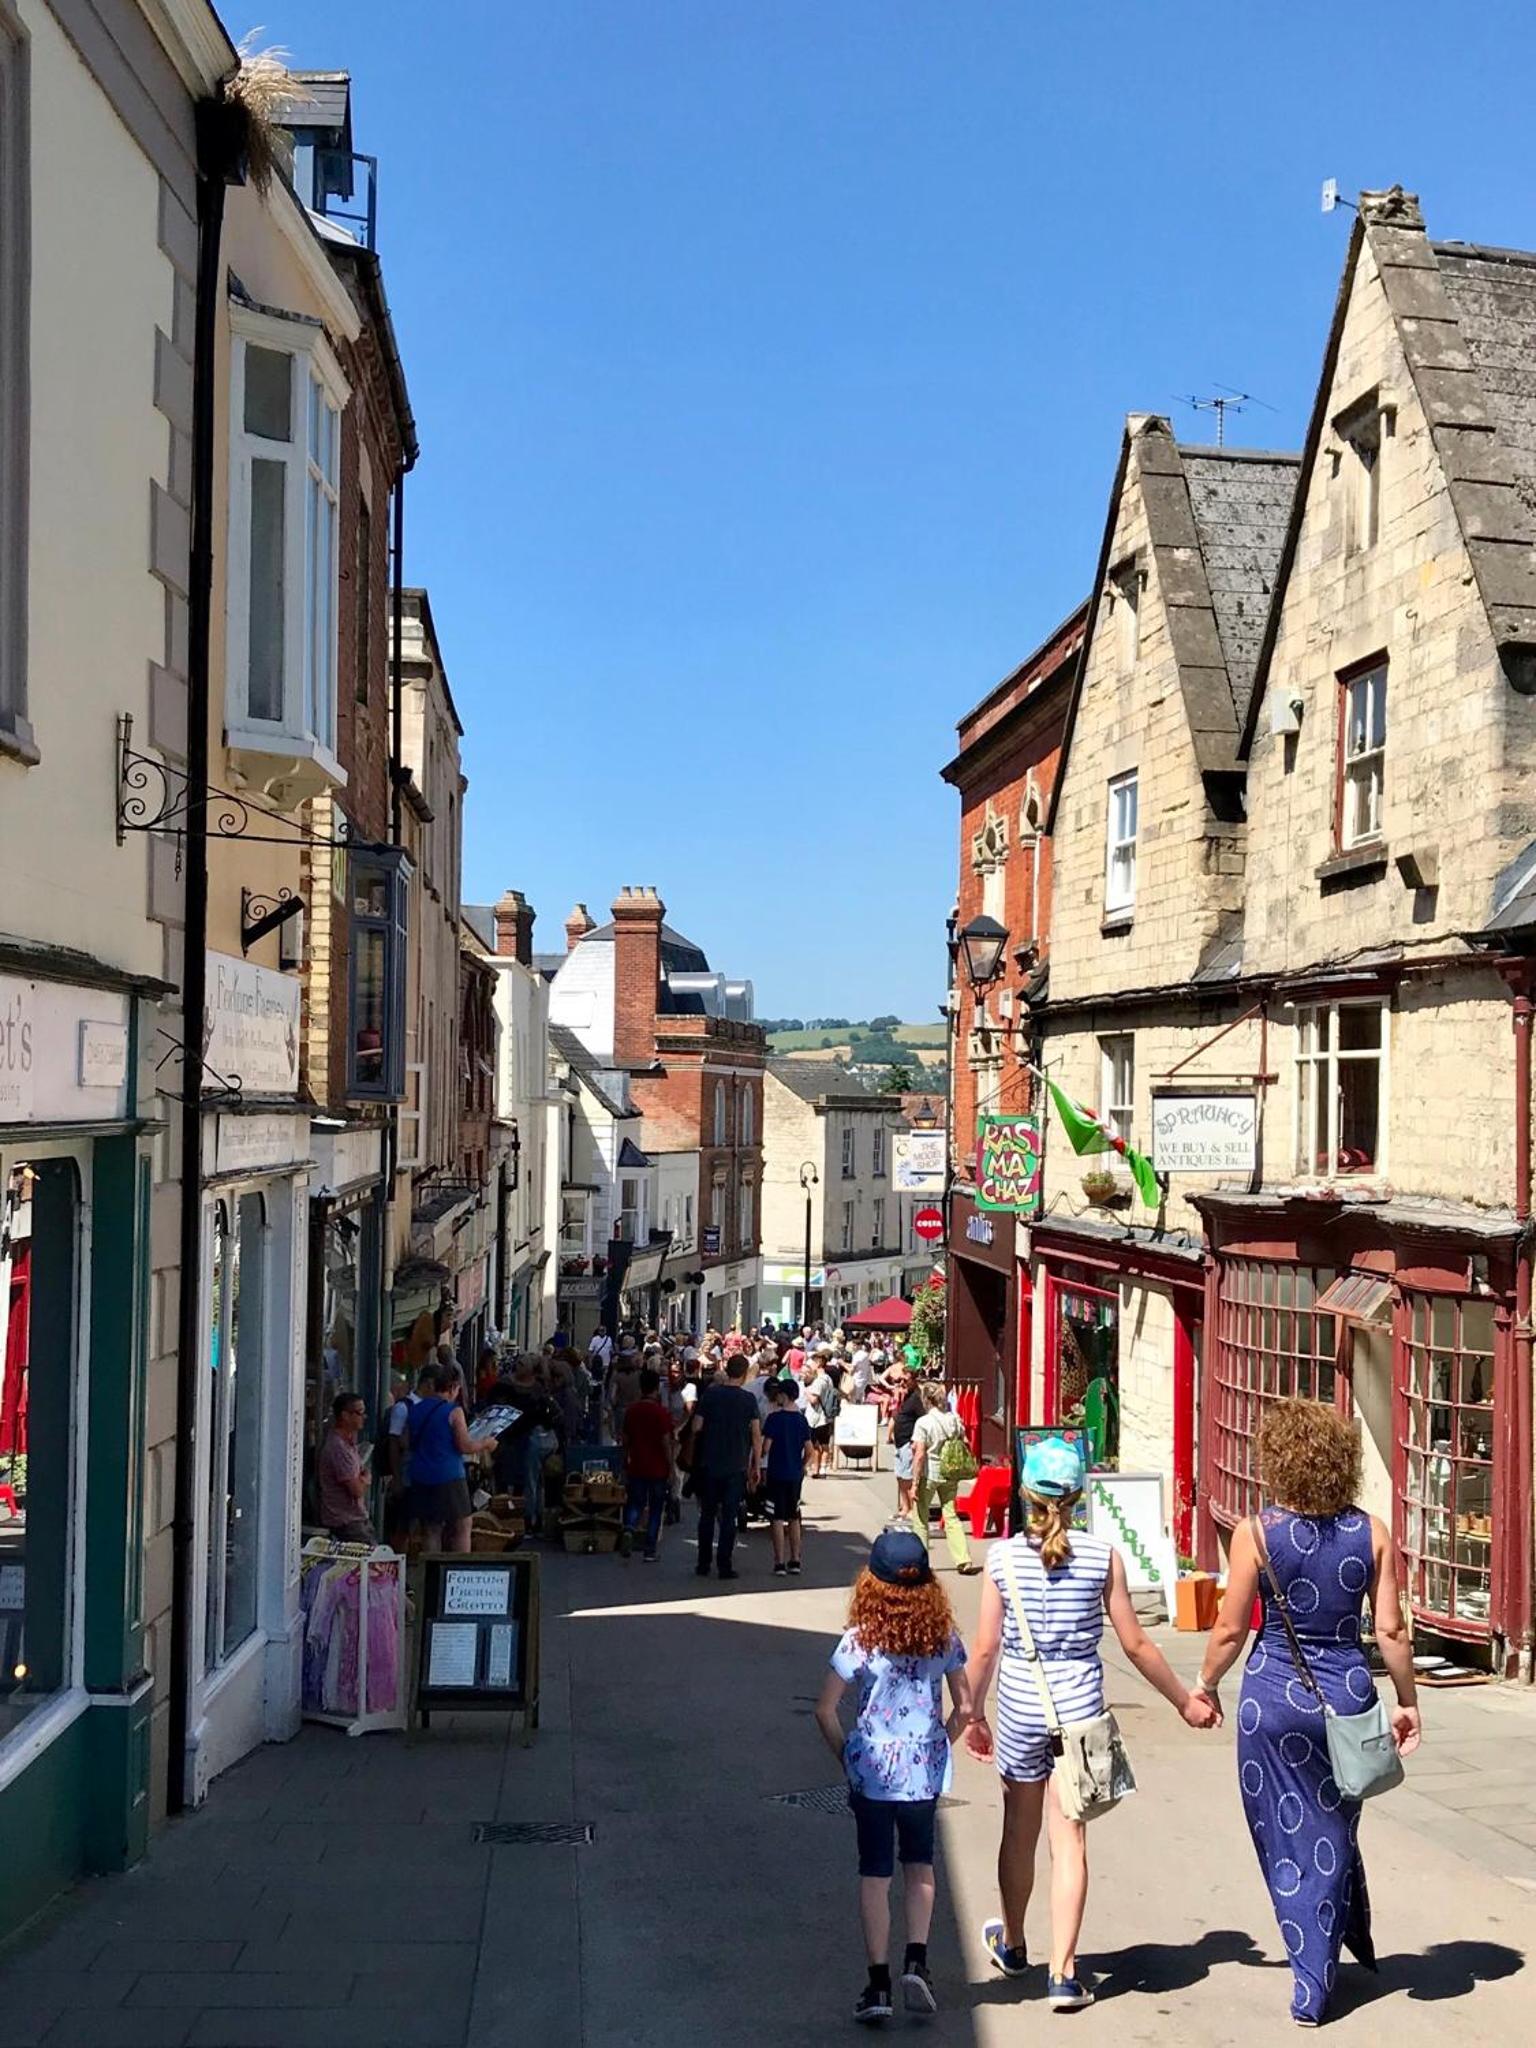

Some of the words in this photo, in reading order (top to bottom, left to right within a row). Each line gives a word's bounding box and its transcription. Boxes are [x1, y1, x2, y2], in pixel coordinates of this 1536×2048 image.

[982, 1122, 1032, 1156] RAS
[1159, 1142, 1179, 1153] WE
[1182, 1142, 1205, 1153] BUY
[1210, 1143, 1222, 1153] &
[1224, 1142, 1251, 1153] SELL
[987, 1152, 1027, 1178] MA
[1157, 1154, 1222, 1167] ANTIQUES
[981, 1177, 1034, 1206] CHAZ
[916, 1219, 943, 1228] COSTA
[1092, 1479, 1160, 1583] ANTIQUES
